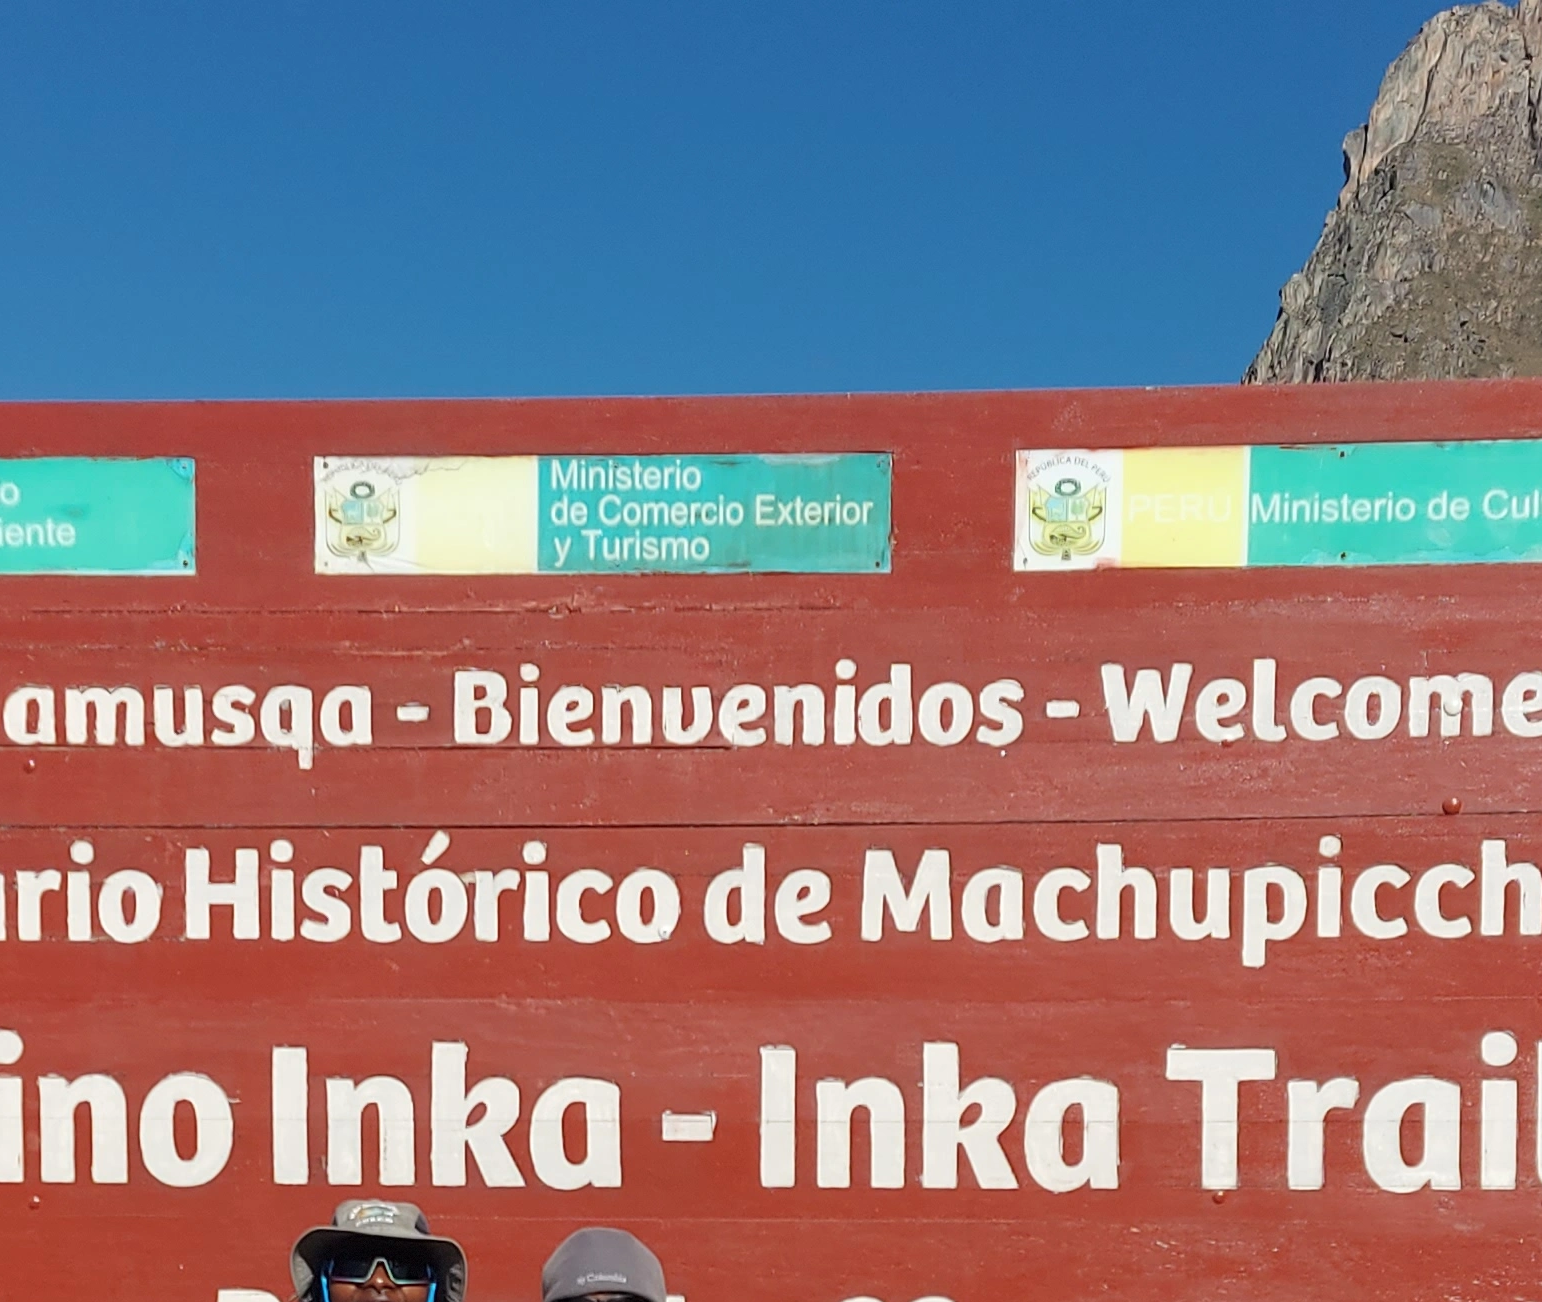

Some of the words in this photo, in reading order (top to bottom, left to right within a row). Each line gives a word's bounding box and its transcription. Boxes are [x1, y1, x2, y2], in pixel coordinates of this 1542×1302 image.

[550, 459, 702, 491] Ministerio
[550, 495, 588, 526] de
[598, 494, 744, 526] Comercio
[754, 494, 873, 526] Exterior
[1250, 491, 1416, 524] Ministerio
[1427, 490, 1470, 521] de
[553, 535, 571, 567] y
[580, 529, 710, 561] Turismo
[454, 659, 1024, 747] Bienvenidos
[184, 831, 681, 944] Histórico
[704, 842, 832, 945] de
[272, 1040, 622, 1190] Inka
[759, 1041, 1121, 1194] Inka
